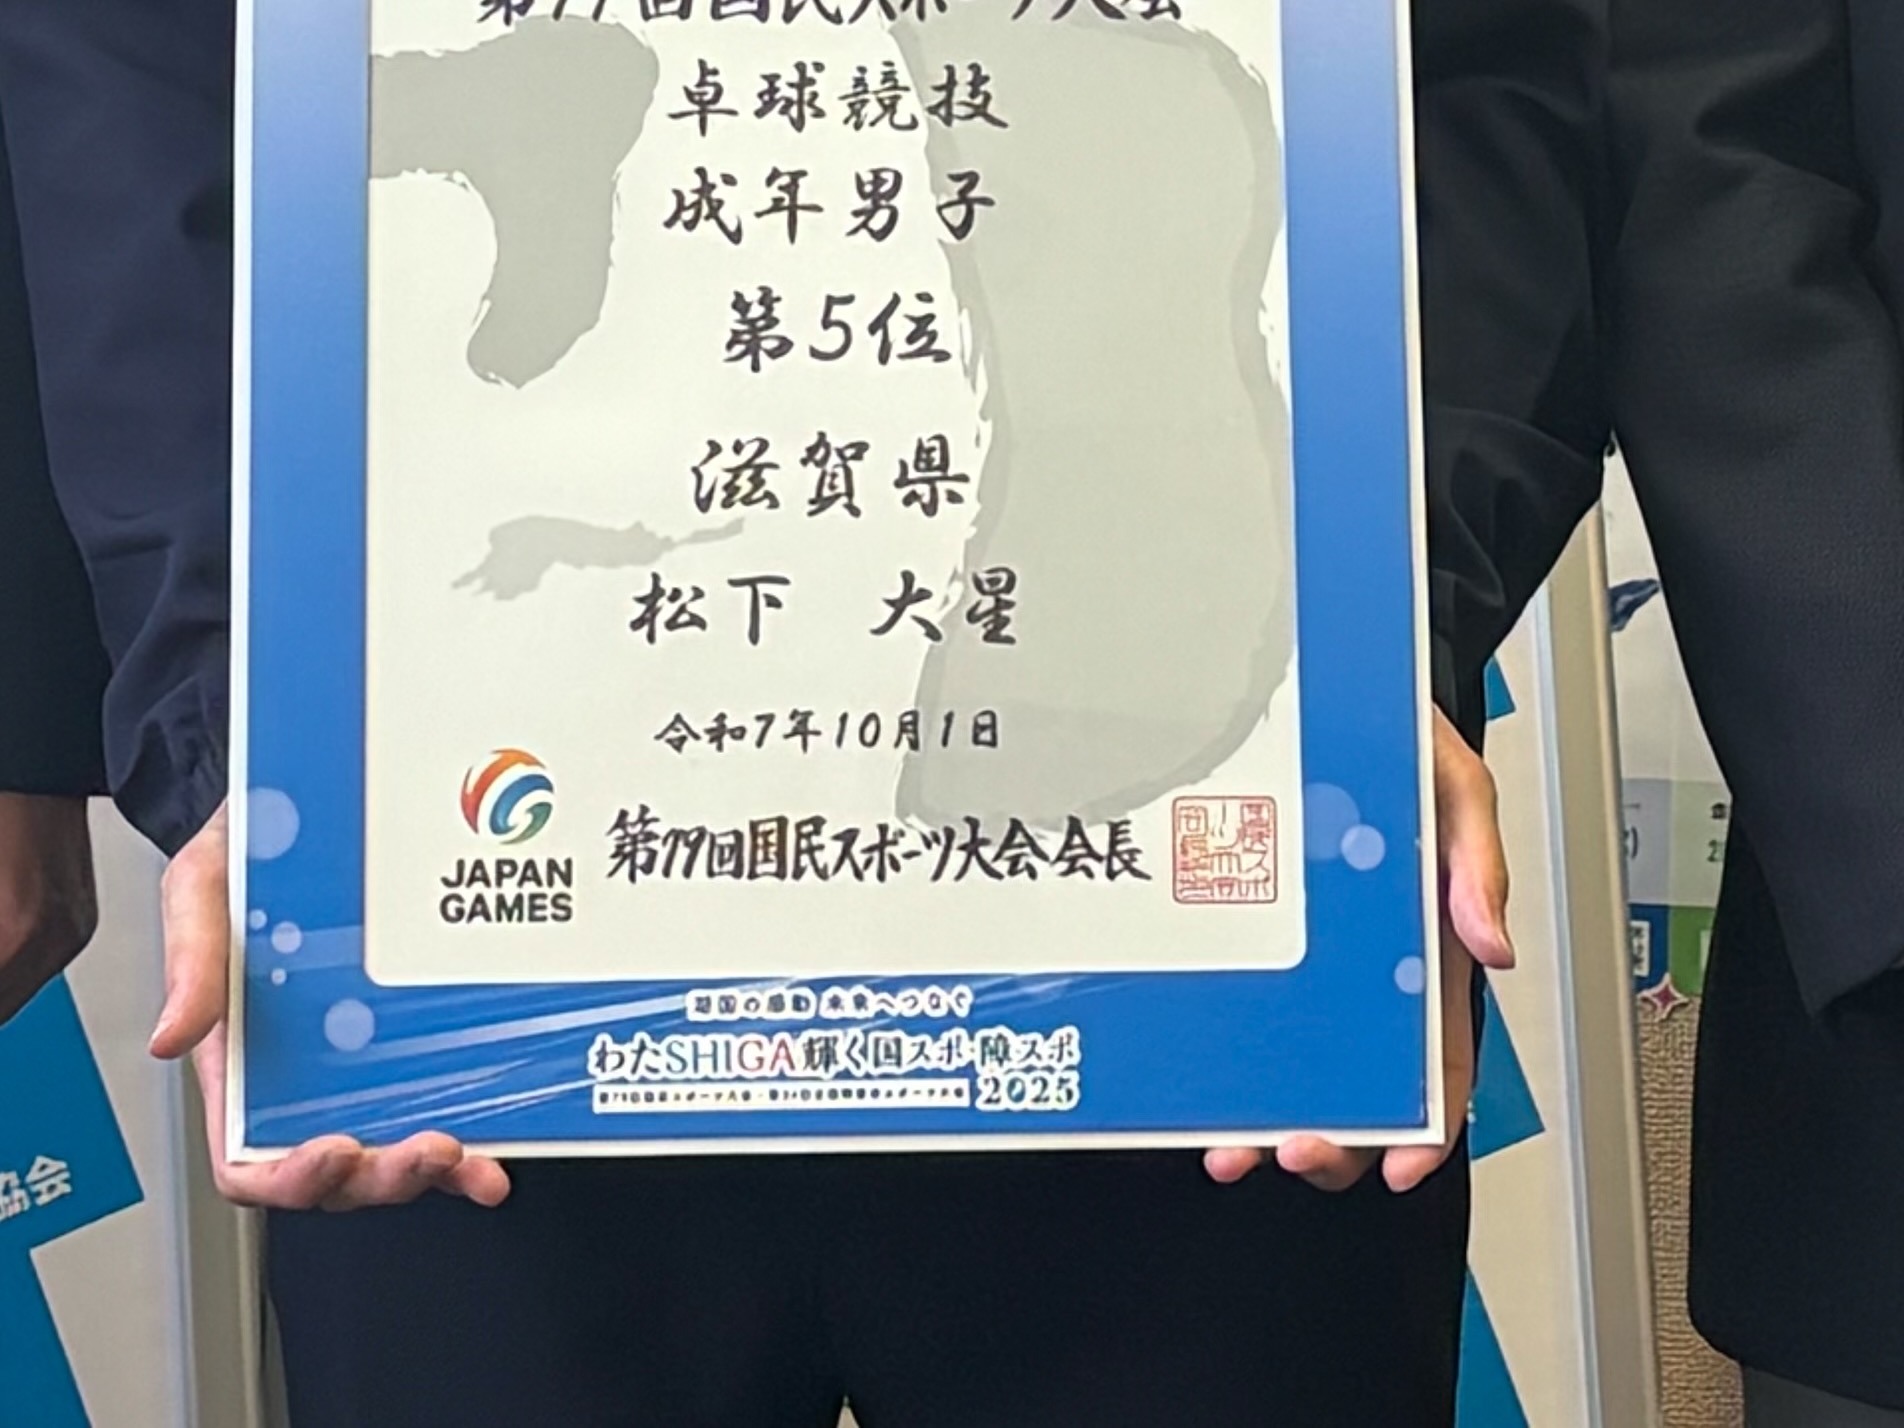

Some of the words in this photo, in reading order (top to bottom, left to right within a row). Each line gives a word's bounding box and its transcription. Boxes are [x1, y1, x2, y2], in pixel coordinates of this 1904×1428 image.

[664, 59, 1010, 138] 卓球競技
[660, 166, 1000, 244] 成年男子
[719, 285, 957, 373] 第5位
[690, 432, 973, 521] 滋賀県
[627, 568, 794, 651] 松下
[868, 564, 1025, 649] 大星
[651, 708, 1002, 755] 令和7年10月1日
[438, 856, 575, 892] JAPAN
[605, 804, 1154, 885] 第79回国民スポーツ大会会長
[437, 891, 575, 925] GAMES
[981, 1075, 1078, 1108] 2025
